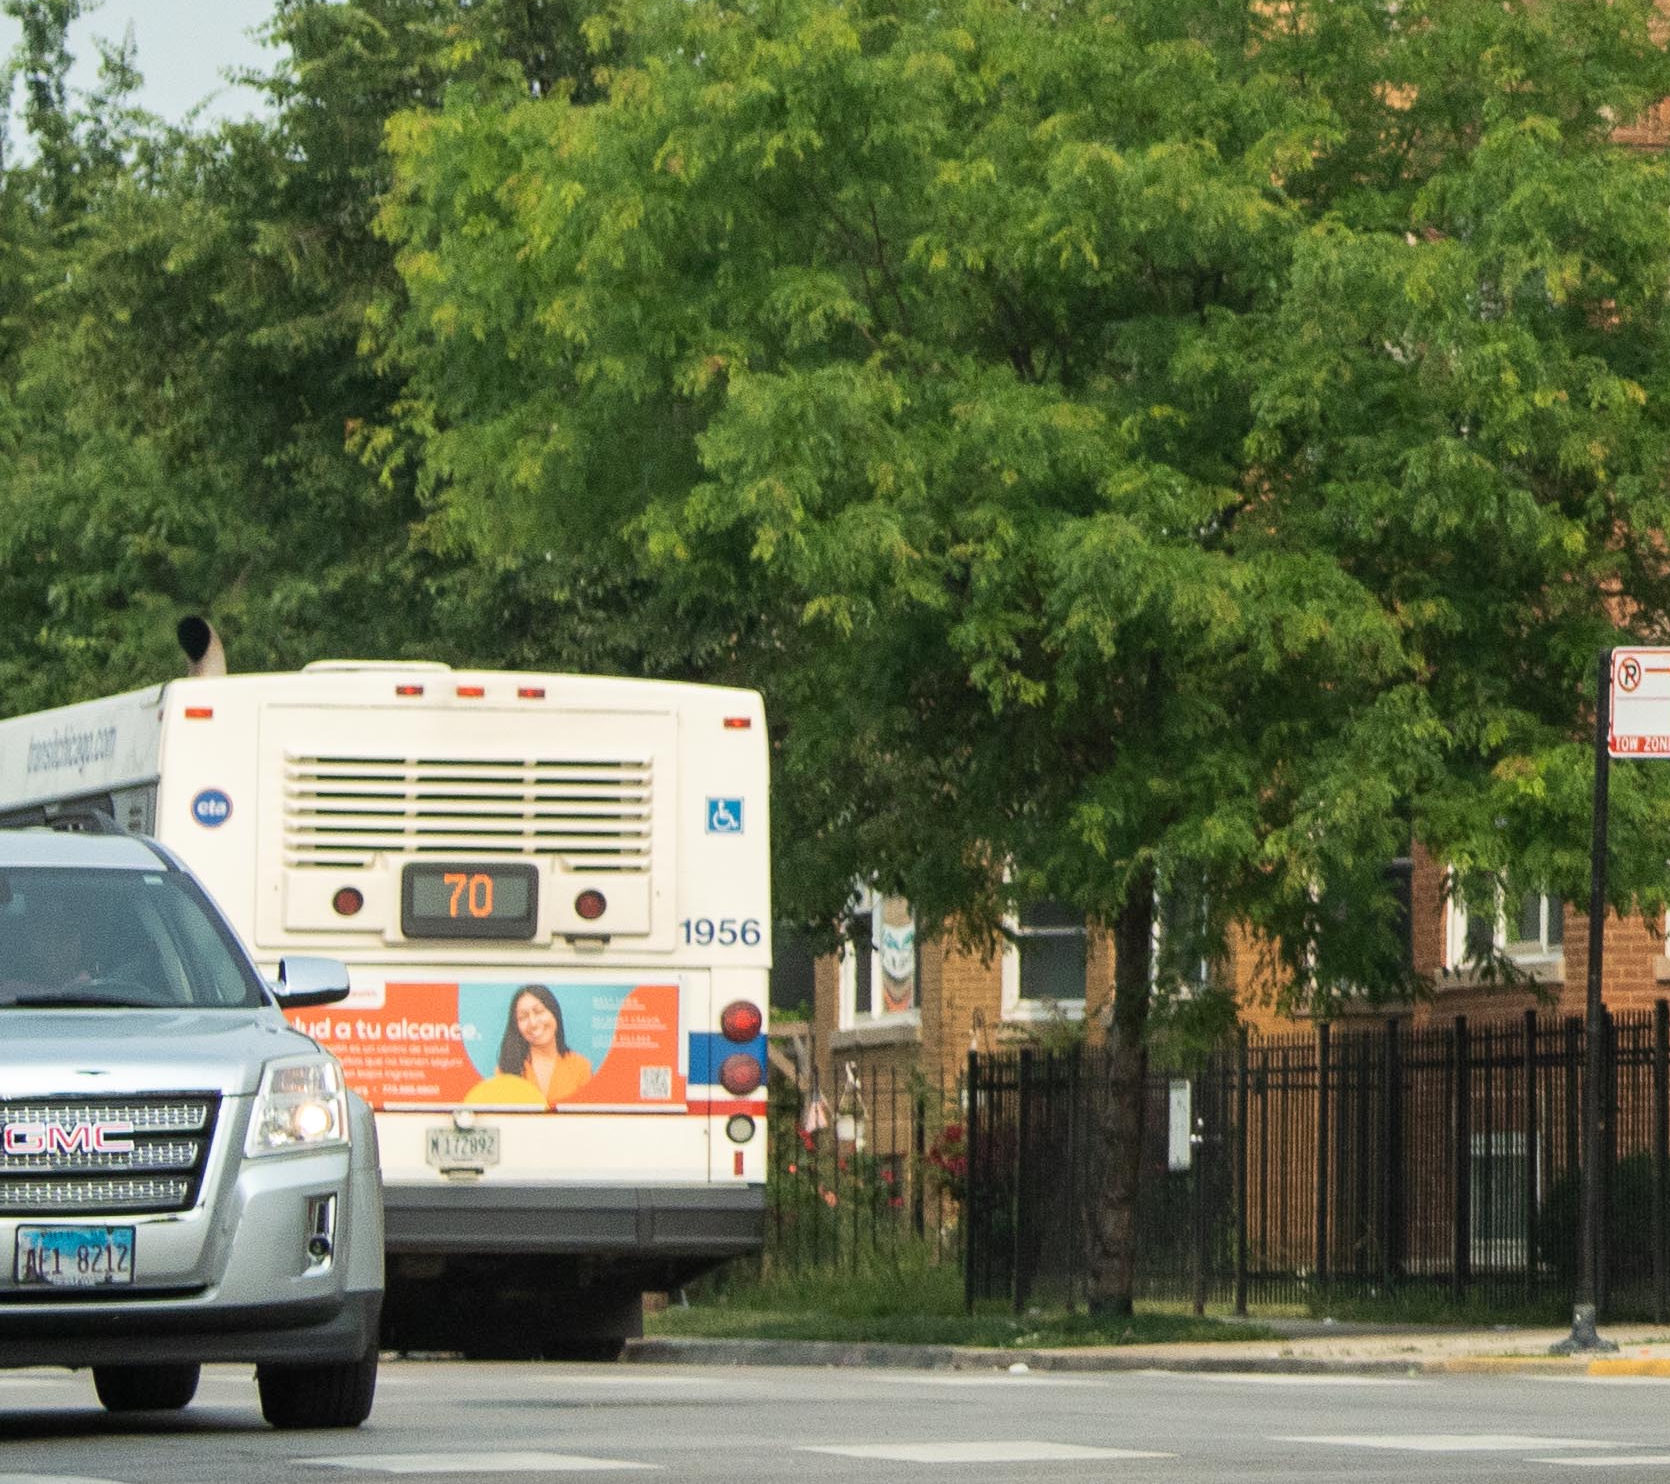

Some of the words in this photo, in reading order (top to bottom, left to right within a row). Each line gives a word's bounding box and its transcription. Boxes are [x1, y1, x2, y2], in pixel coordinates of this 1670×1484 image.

[1616, 736, 1639, 752] TOW
[443, 873, 494, 919] 70
[679, 917, 762, 947] 1956
[292, 1016, 332, 1040] lud
[334, 1021, 352, 1040] a
[355, 1018, 382, 1040] tu
[385, 1017, 482, 1041] alcance.
[4, 1121, 135, 1155] GMC
[77, 1243, 129, 1274] 8212
